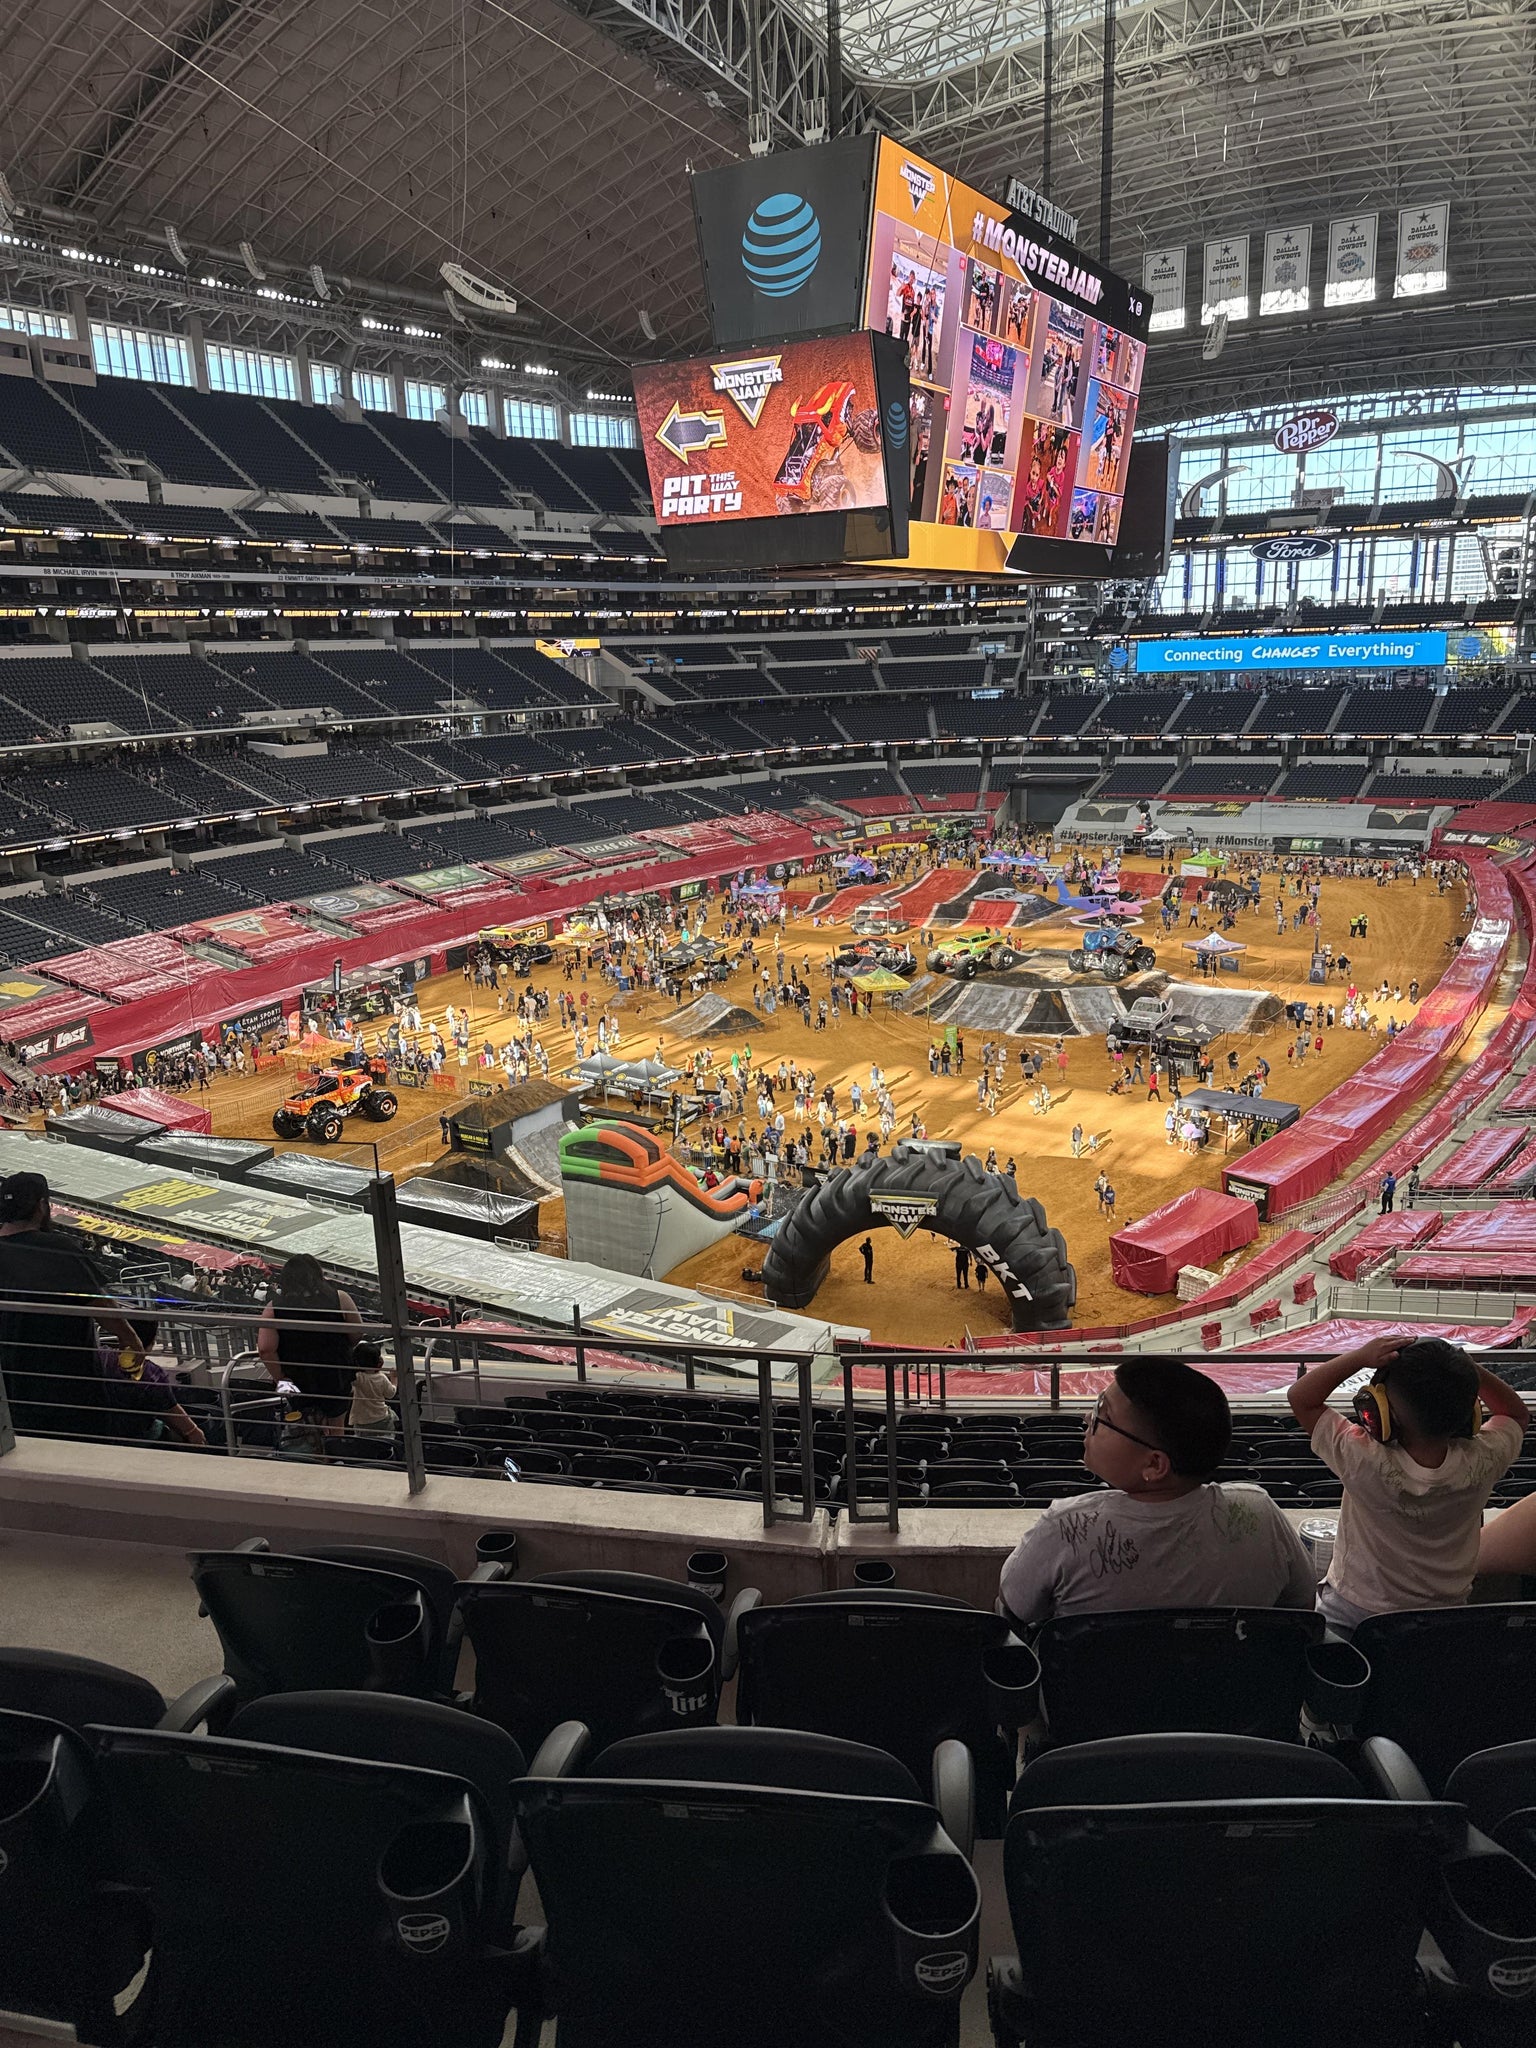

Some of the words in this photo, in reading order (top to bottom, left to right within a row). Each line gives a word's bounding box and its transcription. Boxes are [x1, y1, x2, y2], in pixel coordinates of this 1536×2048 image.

[900, 165, 935, 194] MONSTER
[908, 183, 928, 199] JAM
[1006, 178, 1036, 214] AT&T
[1034, 194, 1079, 244] STADIUM
[1408, 230, 1438, 241] COWBOYS
[1411, 224, 1436, 233] DALLAS
[1338, 241, 1367, 251] COWBOYS
[1341, 235, 1364, 244] DALLAS
[1273, 252, 1301, 261] COWBOYS
[1276, 246, 1299, 254] DALLAS
[972, 211, 1102, 305] #MONSTERJAM
[1215, 256, 1237, 265] DALLAS
[1153, 266, 1175, 274] DALLAS
[1212, 262, 1240, 272] COWBOYS
[1151, 273, 1177, 281] COWBOYS
[713, 368, 783, 390] MONSTER
[735, 385, 766, 400] JAM
[1297, 417, 1321, 434] Dr
[1283, 421, 1335, 450] Pepper
[709, 472, 735, 482] THIS
[663, 475, 706, 497] PIT
[711, 481, 740, 491] WAY
[662, 492, 742, 517] PARTY
[1267, 541, 1317, 558] Ford
[1164, 648, 1243, 665] Connecting
[1251, 645, 1321, 660] CHANGES
[1060, 831, 1128, 842] #MnsterJam
[580, 842, 617, 854] LUCAS
[619, 839, 640, 850] OIL
[1291, 839, 1323, 850] BKT
[413, 867, 471, 888] BKT
[680, 884, 700, 899] BKT
[527, 926, 545, 940] CB
[260, 1007, 281, 1020] SPORTS
[247, 1015, 281, 1033] OMMISSION
[871, 1202, 937, 1216] MONSTER
[175, 1209, 279, 1237] MONSTER
[889, 1214, 920, 1224] JAM
[975, 1243, 1033, 1301] BKT
[653, 1308, 730, 1332] JAM
[606, 1307, 758, 1349] MONSTER
[665, 1688, 708, 1716] Lite
[401, 1922, 447, 1938] PEPSI
[919, 1962, 966, 1977] PEPSI
